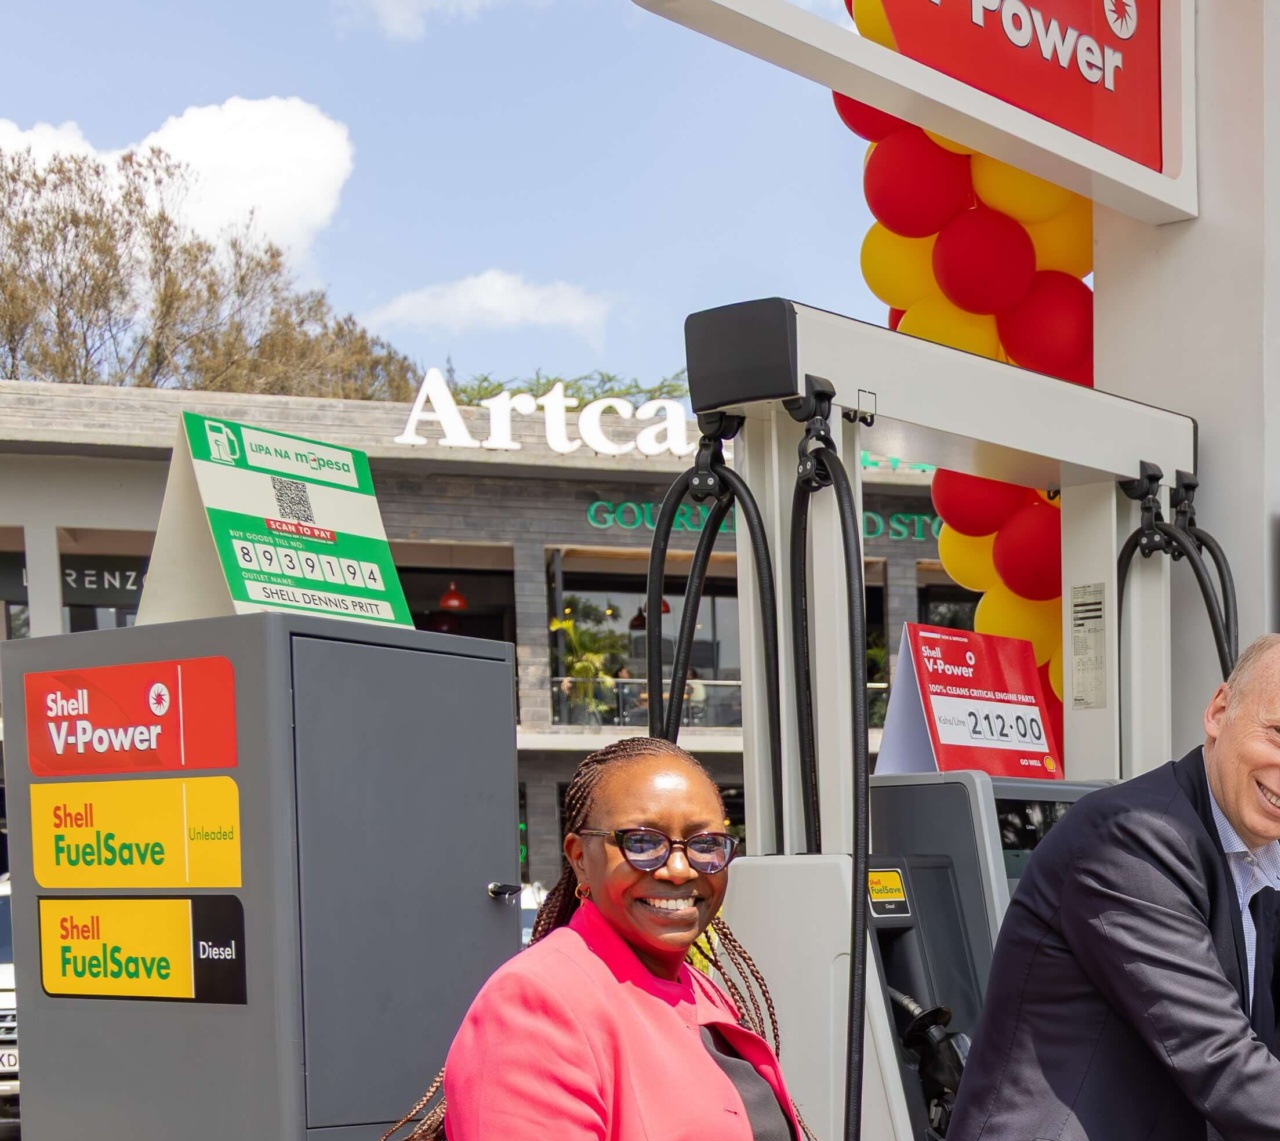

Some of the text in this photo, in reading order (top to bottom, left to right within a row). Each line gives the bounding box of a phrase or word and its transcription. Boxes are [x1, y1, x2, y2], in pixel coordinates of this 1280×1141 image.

[929, 0, 1123, 92] ower
[394, 367, 734, 461] Artca
[249, 442, 272, 457] LIPA
[274, 448, 290, 460] NA
[587, 500, 736, 532] GOURM
[229, 529, 243, 538] BUY
[246, 533, 274, 543] GOODS
[275, 537, 288, 547] TILL
[270, 520, 296, 533] SCAN
[298, 525, 311, 535] TO
[314, 529, 331, 539] PAY
[242, 571, 268, 581] OUTLET
[262, 586, 380, 616] SHELL DENNIS PRITT
[921, 645, 942, 658] Shell
[924, 658, 974, 678] V-Power
[46, 689, 89, 717] Shell
[928, 684, 1036, 704] 100% CLEANS CRITICAL ENGINE PARTS
[48, 720, 162, 755] V-Power
[1020, 758, 1041, 767] GO WELL
[53, 803, 94, 829] Shell
[188, 826, 234, 841] Unleaded
[54, 830, 165, 867] FuelSave
[871, 885, 902, 894] FuelSave
[59, 915, 100, 940] Shell
[199, 940, 236, 960] Diesel
[60, 943, 171, 980] FuelSave
